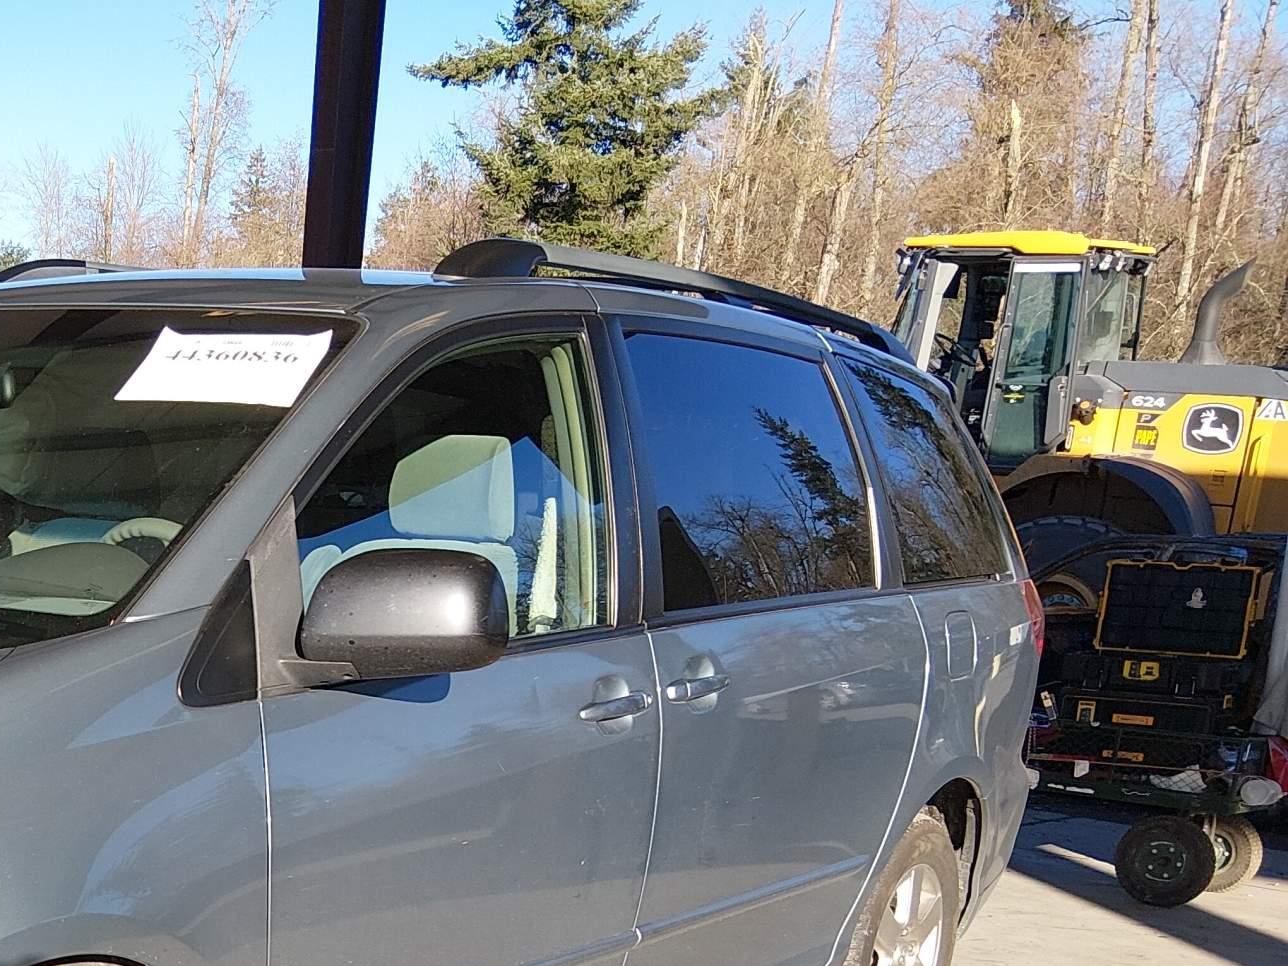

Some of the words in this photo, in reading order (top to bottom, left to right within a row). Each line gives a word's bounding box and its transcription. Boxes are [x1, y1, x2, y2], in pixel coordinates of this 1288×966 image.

[165, 349, 299, 363] 44360836
[1131, 395, 1166, 408] 624
[1140, 414, 1151, 423] P
